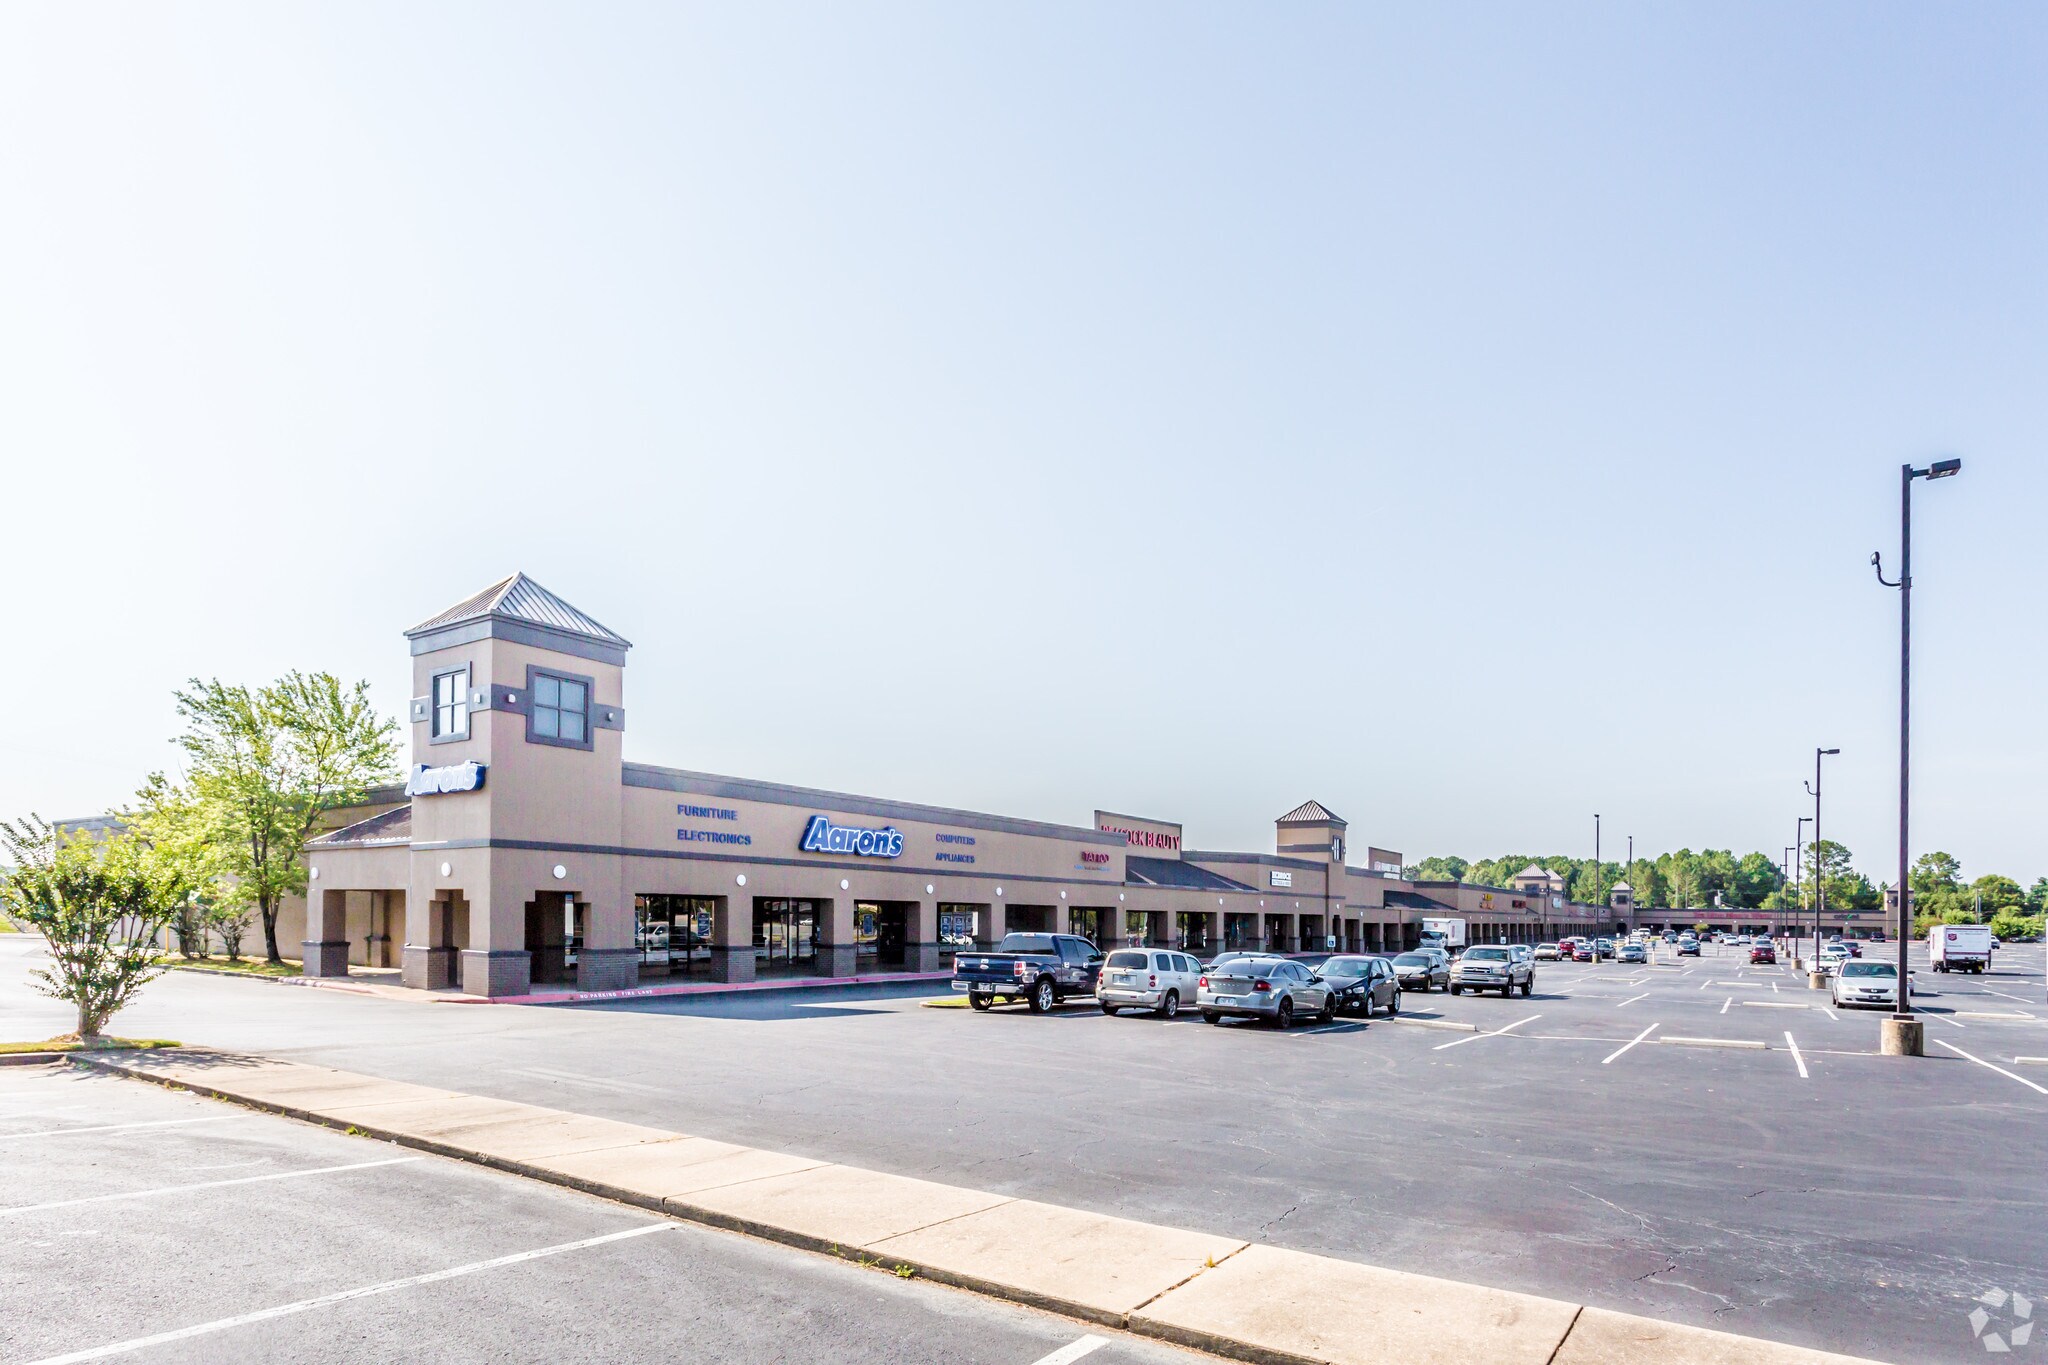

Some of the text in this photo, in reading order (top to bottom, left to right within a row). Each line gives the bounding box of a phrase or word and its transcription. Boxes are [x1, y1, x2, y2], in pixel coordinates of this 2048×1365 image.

[677, 804, 738, 821] FURNITURE
[677, 829, 752, 846] ELECTRONICS
[802, 816, 904, 858] Aaron's
[935, 833, 976, 846] COMPUTERS
[1145, 832, 1180, 850] BEAUTY
[935, 852, 976, 864] APPLIANCES
